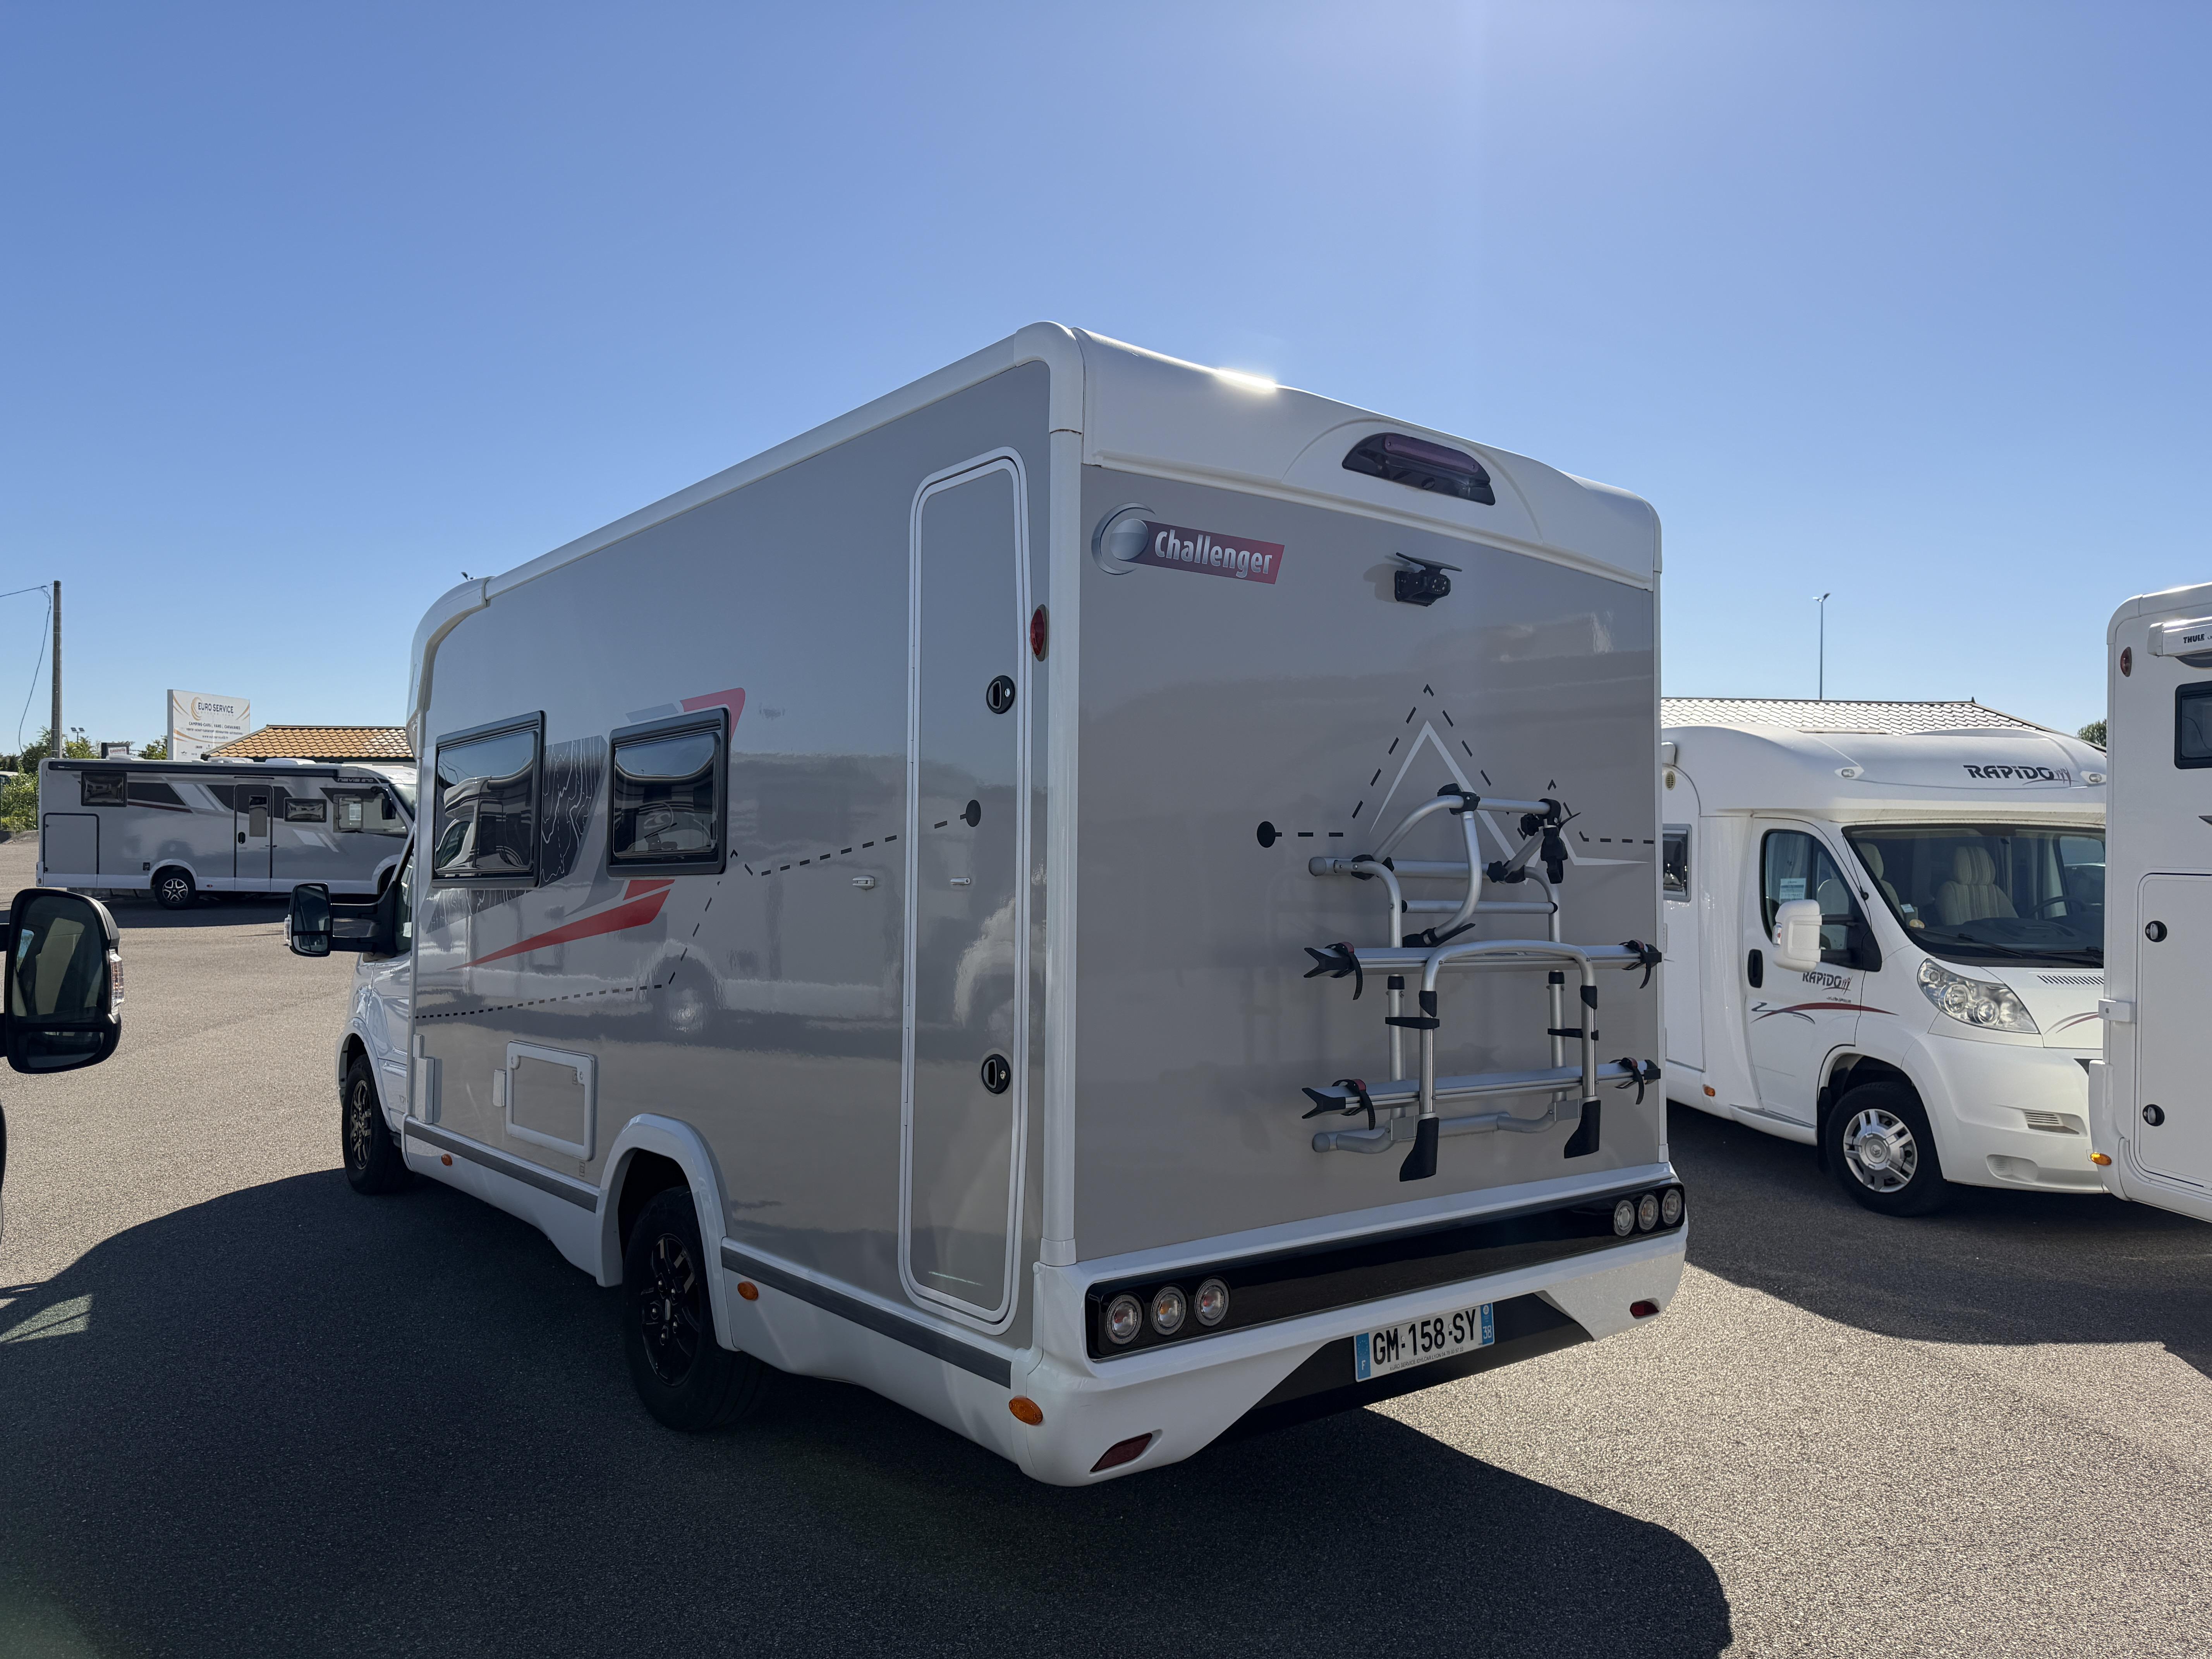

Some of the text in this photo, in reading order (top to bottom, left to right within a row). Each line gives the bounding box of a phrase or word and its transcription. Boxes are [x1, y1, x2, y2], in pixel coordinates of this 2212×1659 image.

[1155, 529, 1272, 578] Challenger
[2183, 634, 2205, 643] THULE
[198, 702, 234, 713] EURO SERVICE
[1373, 1309, 1476, 1365] GM-158-SY
[1482, 1325, 1492, 1339] 38
[1361, 1360, 1366, 1370] F
[1401, 1360, 1416, 1368] SERVICE
